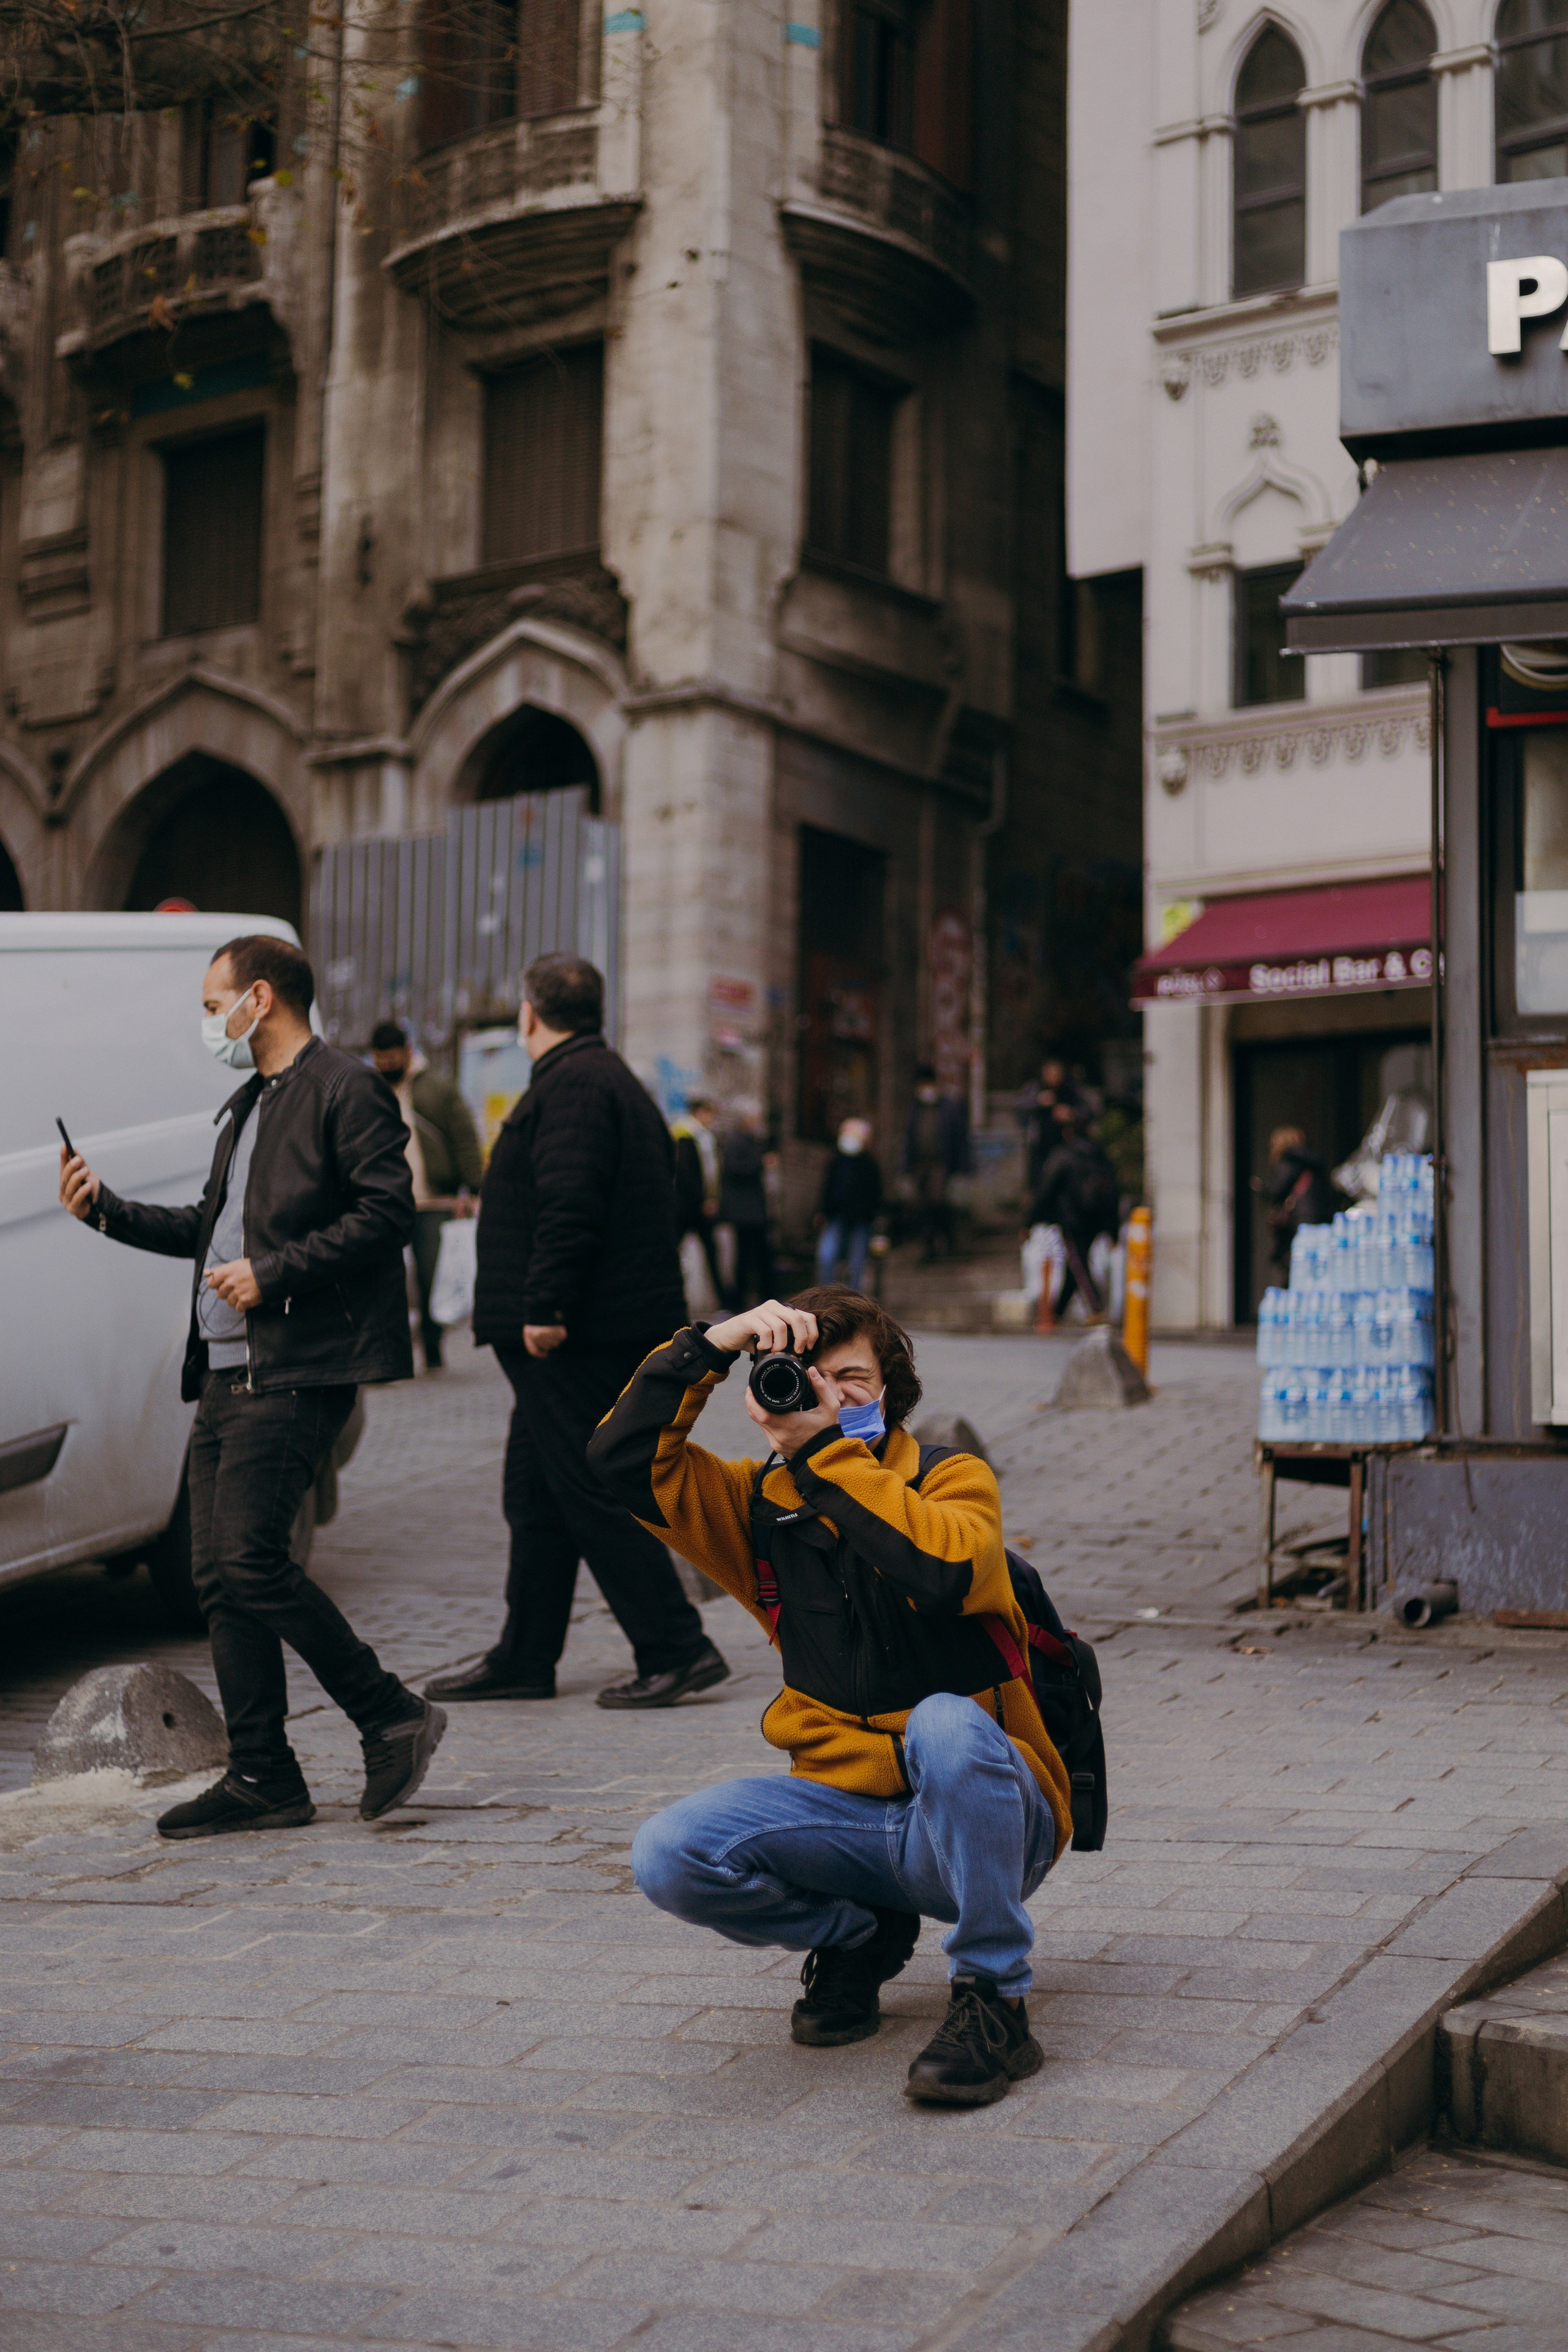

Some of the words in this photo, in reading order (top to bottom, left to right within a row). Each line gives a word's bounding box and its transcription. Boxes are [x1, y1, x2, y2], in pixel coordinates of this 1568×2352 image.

[1487, 255, 1568, 355] P
[1249, 959, 1330, 994] Social
[1332, 956, 1381, 986] Bar
[1384, 951, 1406, 981] &
[785, 1365, 796, 1375] FUJINON
[776, 1513, 798, 1521] FUJIFILM
